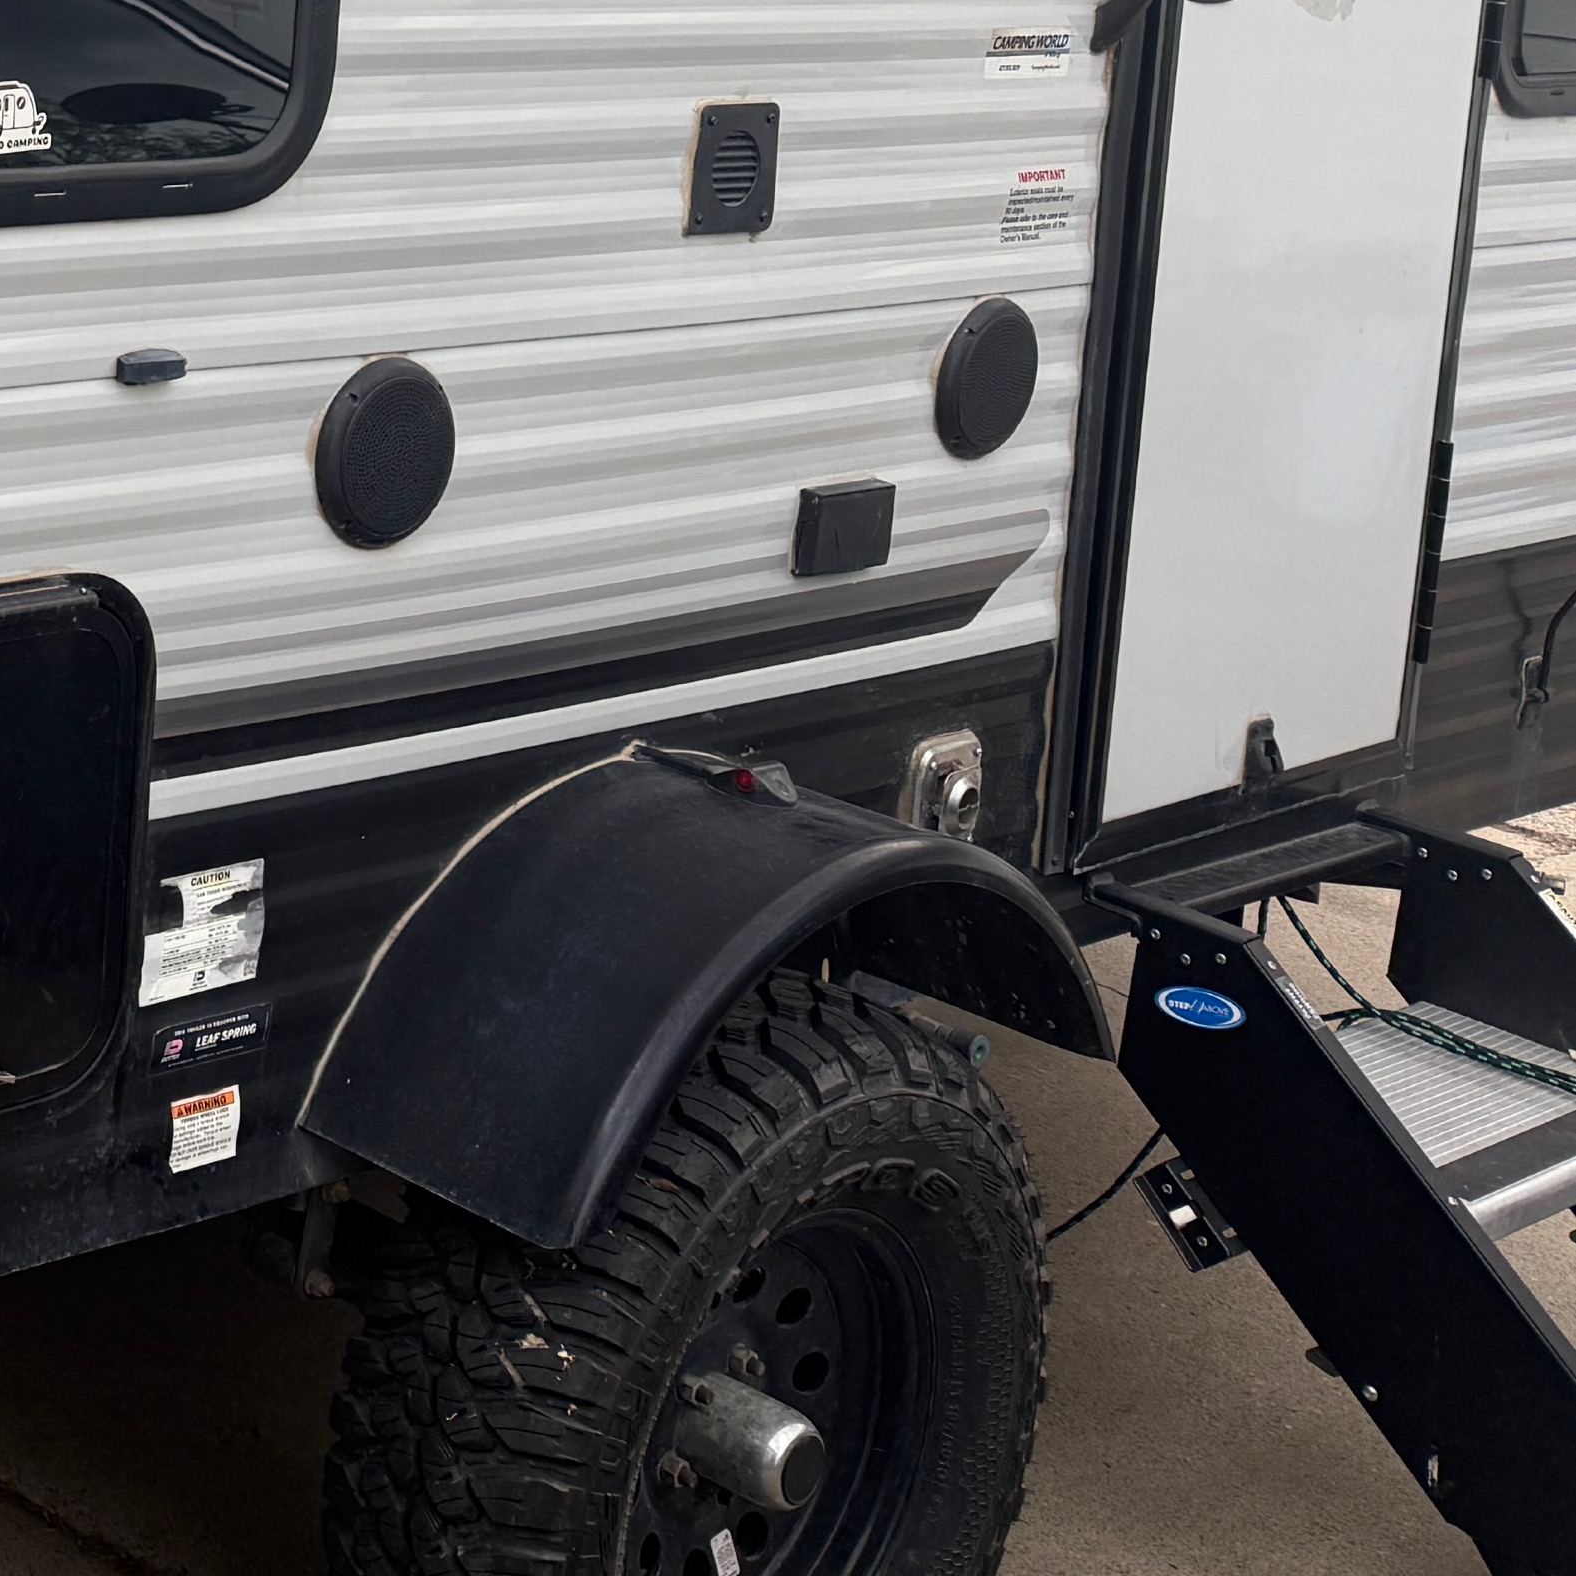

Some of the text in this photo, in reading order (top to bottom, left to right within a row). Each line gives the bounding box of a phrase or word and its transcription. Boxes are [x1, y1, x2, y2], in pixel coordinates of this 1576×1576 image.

[993, 34, 1069, 50] CAMPING WORLD
[7, 136, 49, 149] CAMPING
[1018, 169, 1065, 183] IMPORTANT
[190, 870, 231, 887] CAUTION
[195, 1023, 257, 1048] LEAF SPRING
[184, 1095, 227, 1117] WARNING
